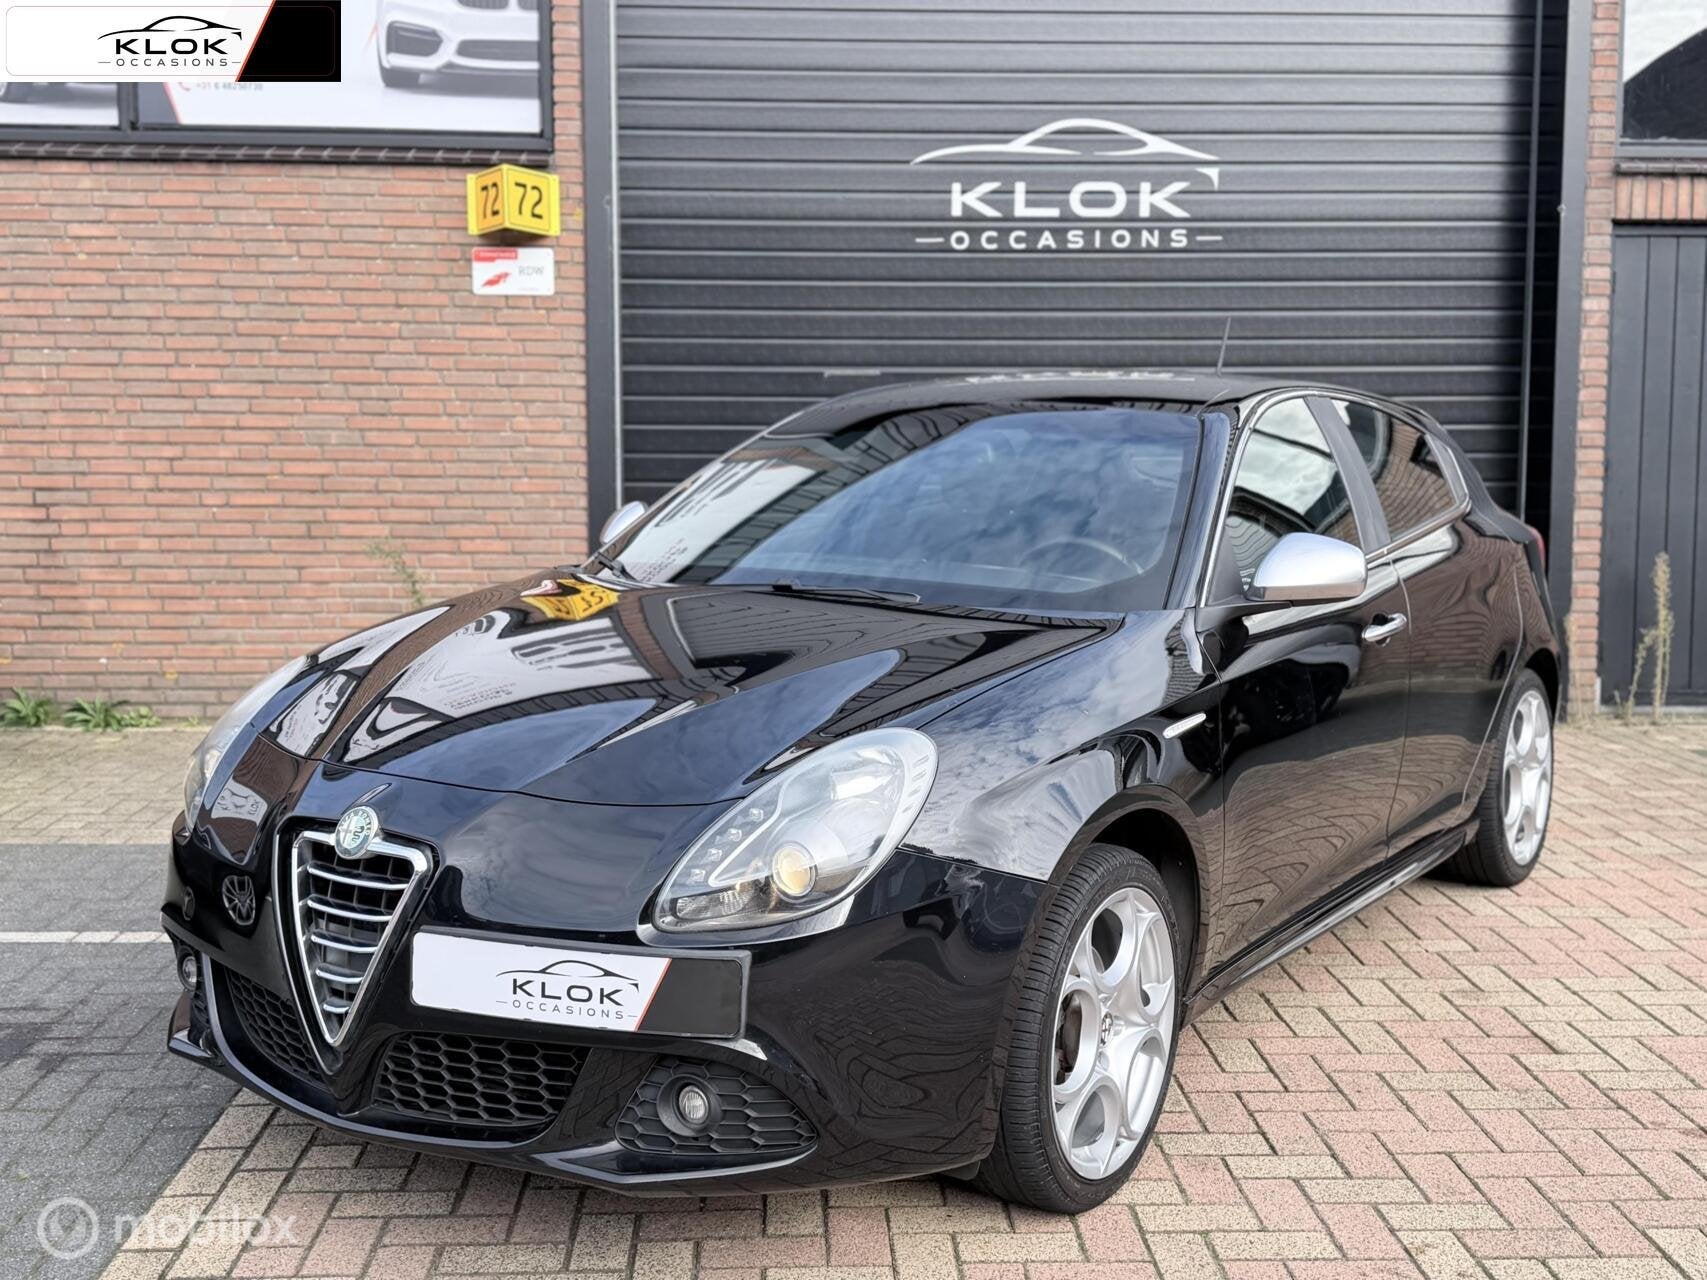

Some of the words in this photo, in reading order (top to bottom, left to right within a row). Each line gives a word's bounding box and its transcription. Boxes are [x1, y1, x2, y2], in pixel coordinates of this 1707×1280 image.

[481, 181, 499, 219] 72
[514, 182, 543, 219] 72
[950, 181, 1192, 218] KLOK
[949, 228, 1189, 250] OCCASIONS
[512, 978, 624, 1007] KLOK
[512, 999, 624, 1020] OCCASIONS
